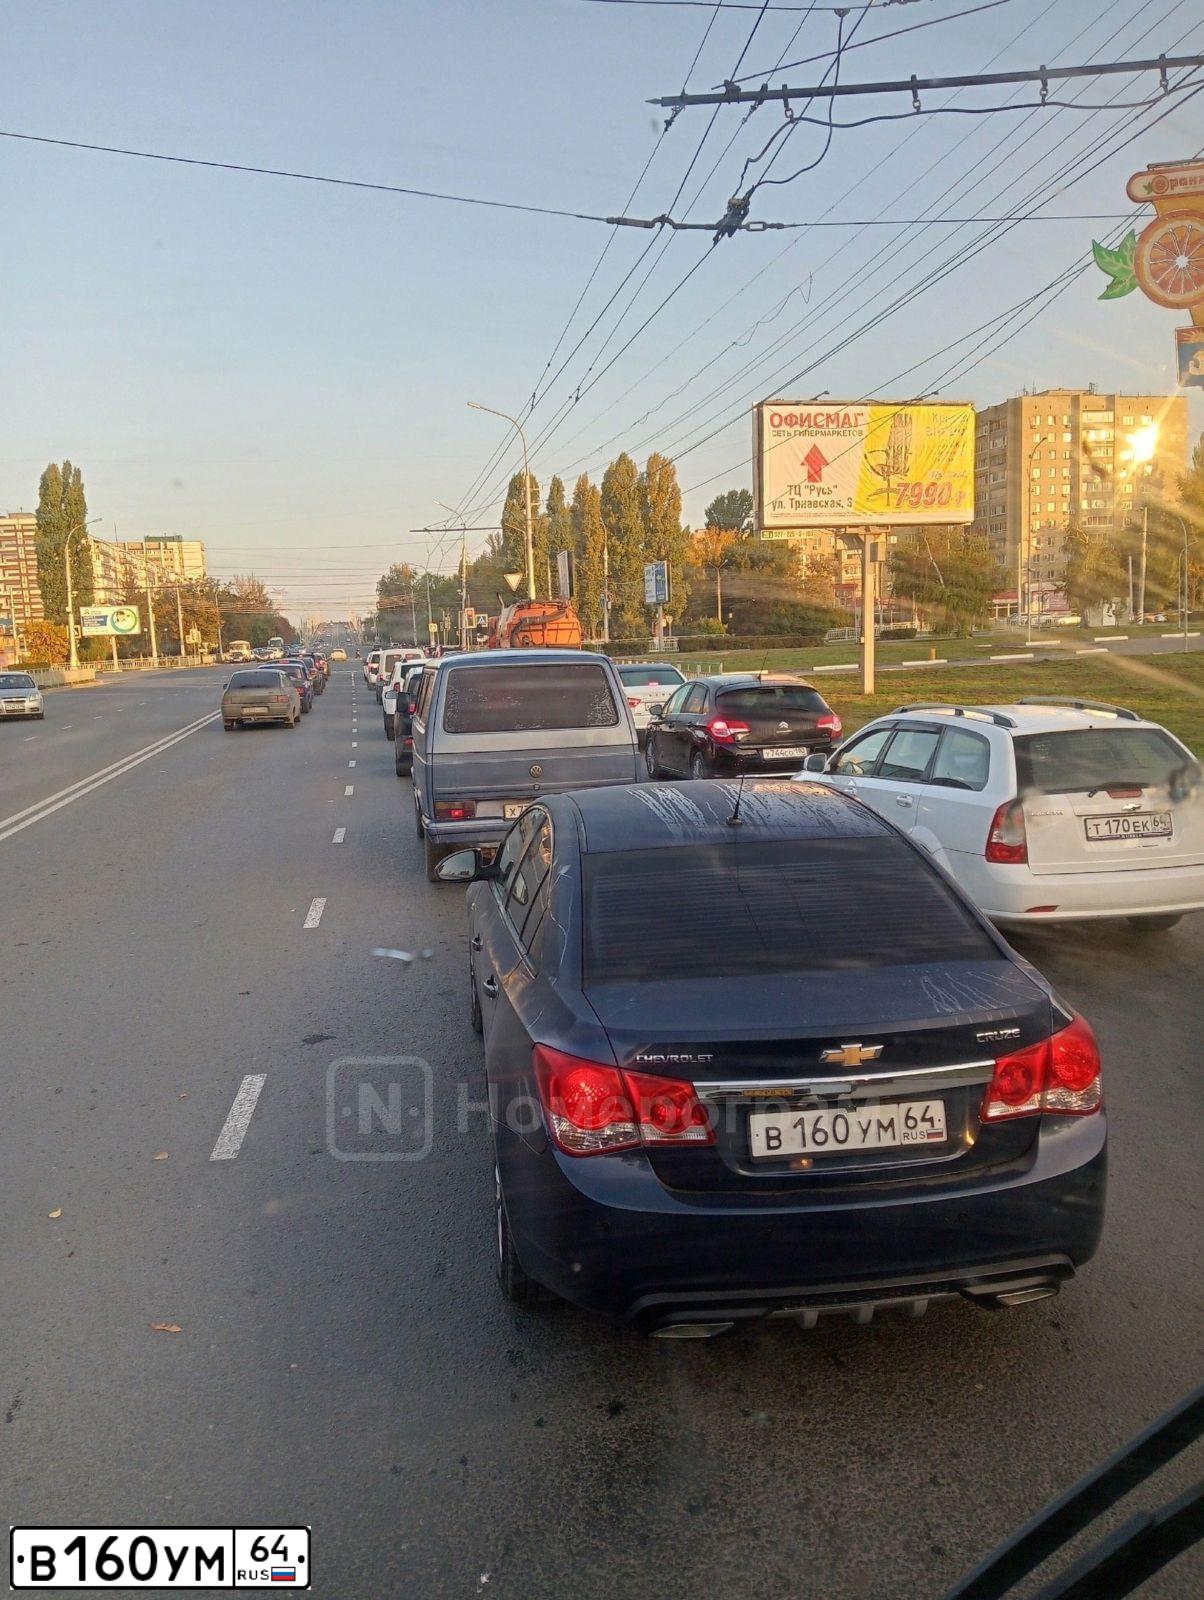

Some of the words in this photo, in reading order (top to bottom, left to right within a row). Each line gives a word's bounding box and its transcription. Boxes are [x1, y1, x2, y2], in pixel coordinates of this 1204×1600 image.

[769, 412, 864, 429] ОФИСМАГ
[771, 429, 792, 438] СЕТЬ
[794, 429, 864, 437] ГИПЕРМАРКЕТОВ
[787, 484, 801, 497] ТЦ
[895, 481, 953, 509] 7990
[771, 500, 786, 511] ул.
[1092, 818, 1150, 835] Т170ЕК
[976, 1028, 1021, 1043] CRUZE
[636, 1054, 714, 1064] CHEVROLET
[765, 1113, 896, 1150] В160УМ
[904, 1105, 934, 1129] 64
[903, 1130, 926, 1141] RUS
